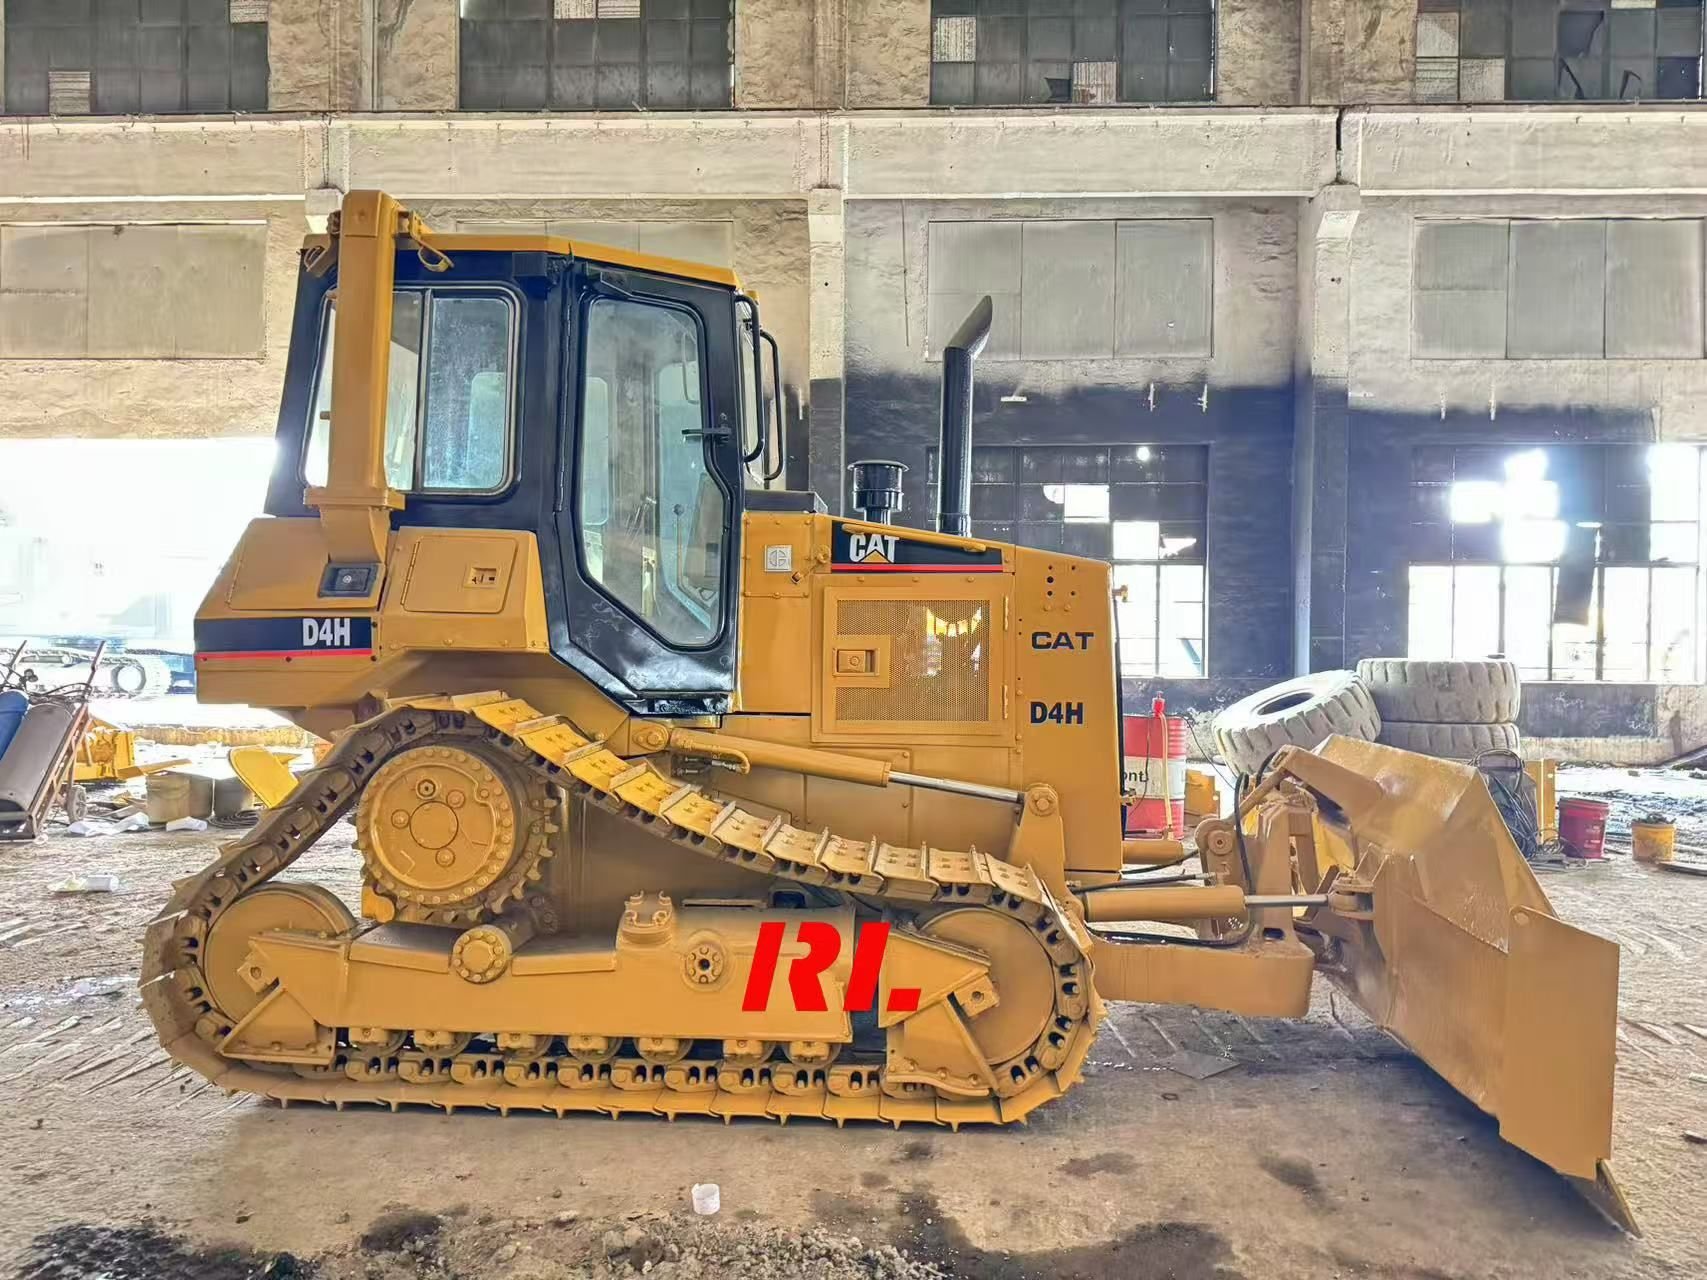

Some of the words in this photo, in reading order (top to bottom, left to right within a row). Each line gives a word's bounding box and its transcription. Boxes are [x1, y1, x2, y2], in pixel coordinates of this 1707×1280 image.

[849, 534, 899, 563] CAT
[302, 617, 351, 646] D4H
[1031, 631, 1094, 650] CAT
[1030, 701, 1083, 724] D4H
